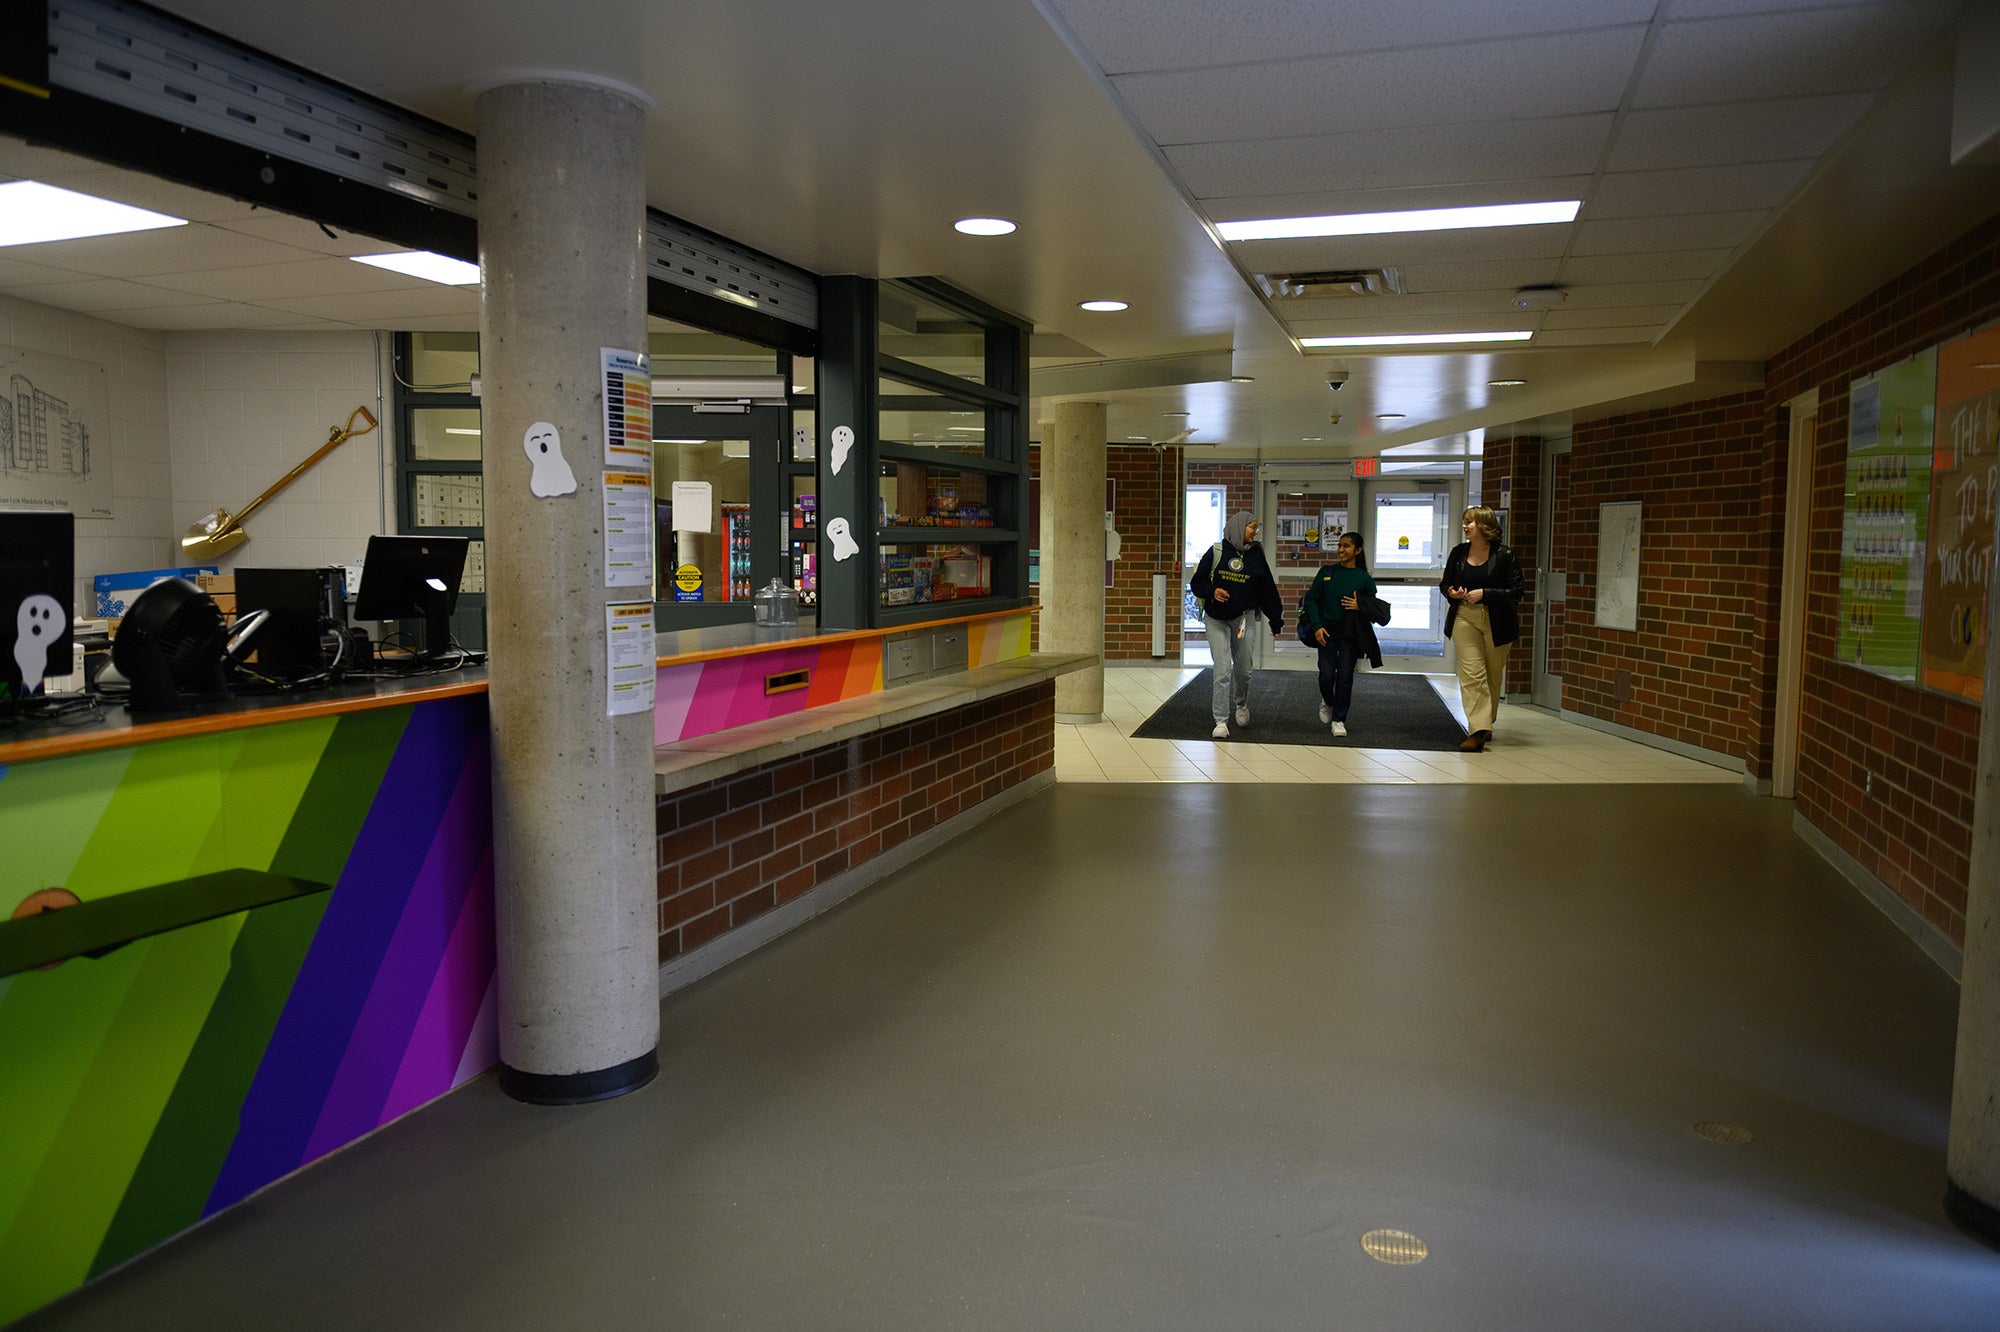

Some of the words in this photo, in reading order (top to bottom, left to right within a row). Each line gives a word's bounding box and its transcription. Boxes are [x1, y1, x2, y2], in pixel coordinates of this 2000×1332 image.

[1950, 399, 1982, 470] THE
[1355, 459, 1376, 476] EXIT
[1956, 474, 1979, 536] TO
[1218, 570, 1244, 578] UNIVERSITY
[1221, 575, 1246, 584] WATERLOO
[1937, 542, 1962, 590] YOUR
